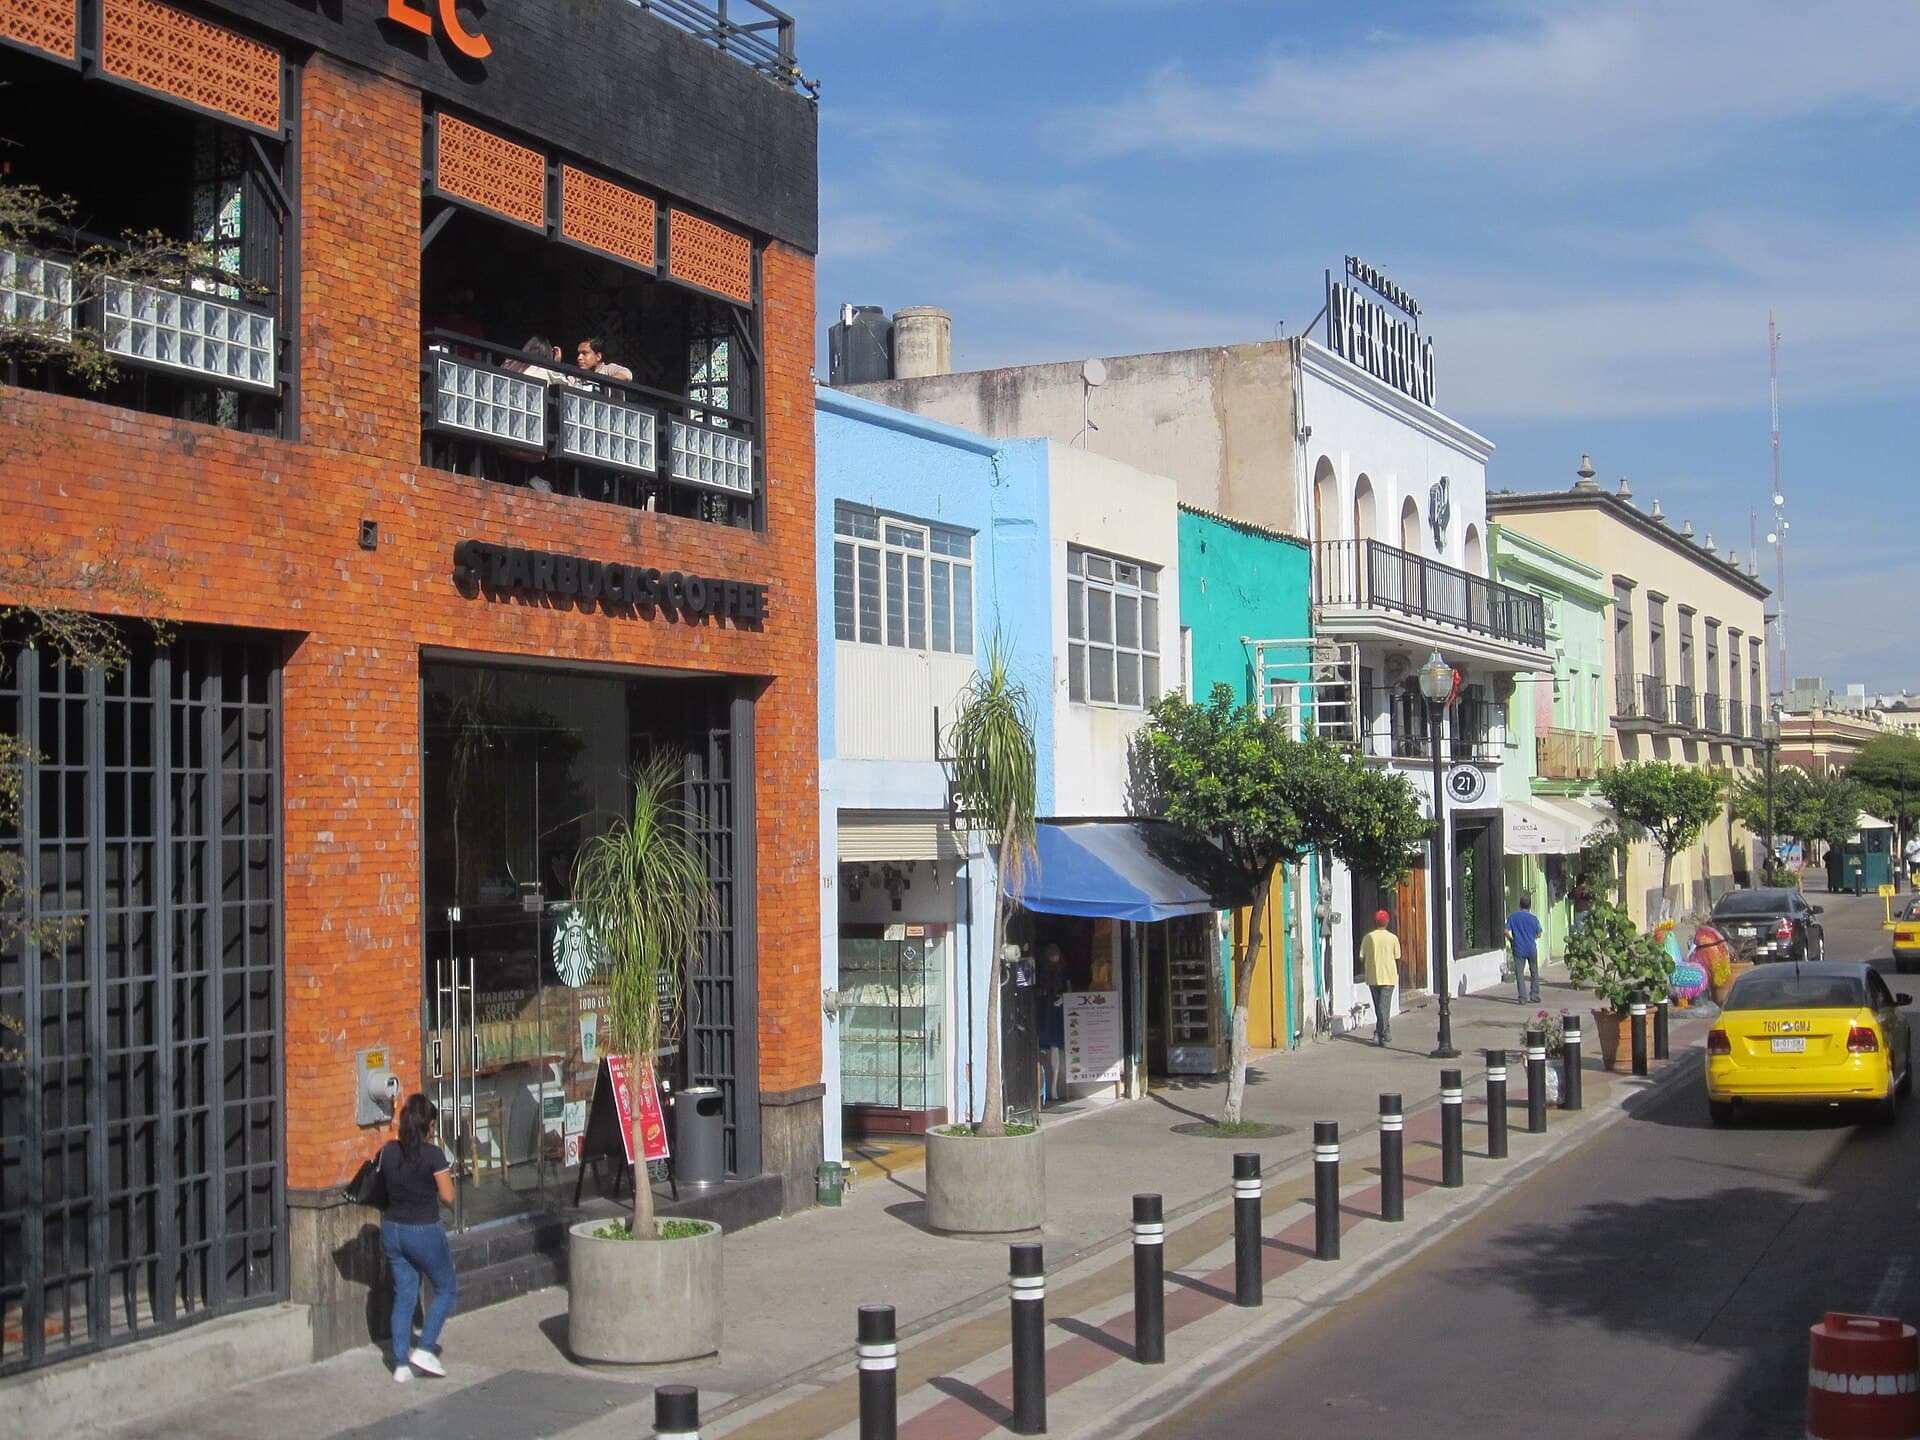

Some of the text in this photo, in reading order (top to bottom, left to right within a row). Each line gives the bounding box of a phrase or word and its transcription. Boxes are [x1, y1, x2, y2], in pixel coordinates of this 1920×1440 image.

[1332, 282, 1436, 408] VEINTIUNO
[454, 540, 769, 618] STARBUCKS COFFEE
[1457, 776, 1471, 791] 21
[1763, 1020, 1811, 1033] 7601 GMJ
